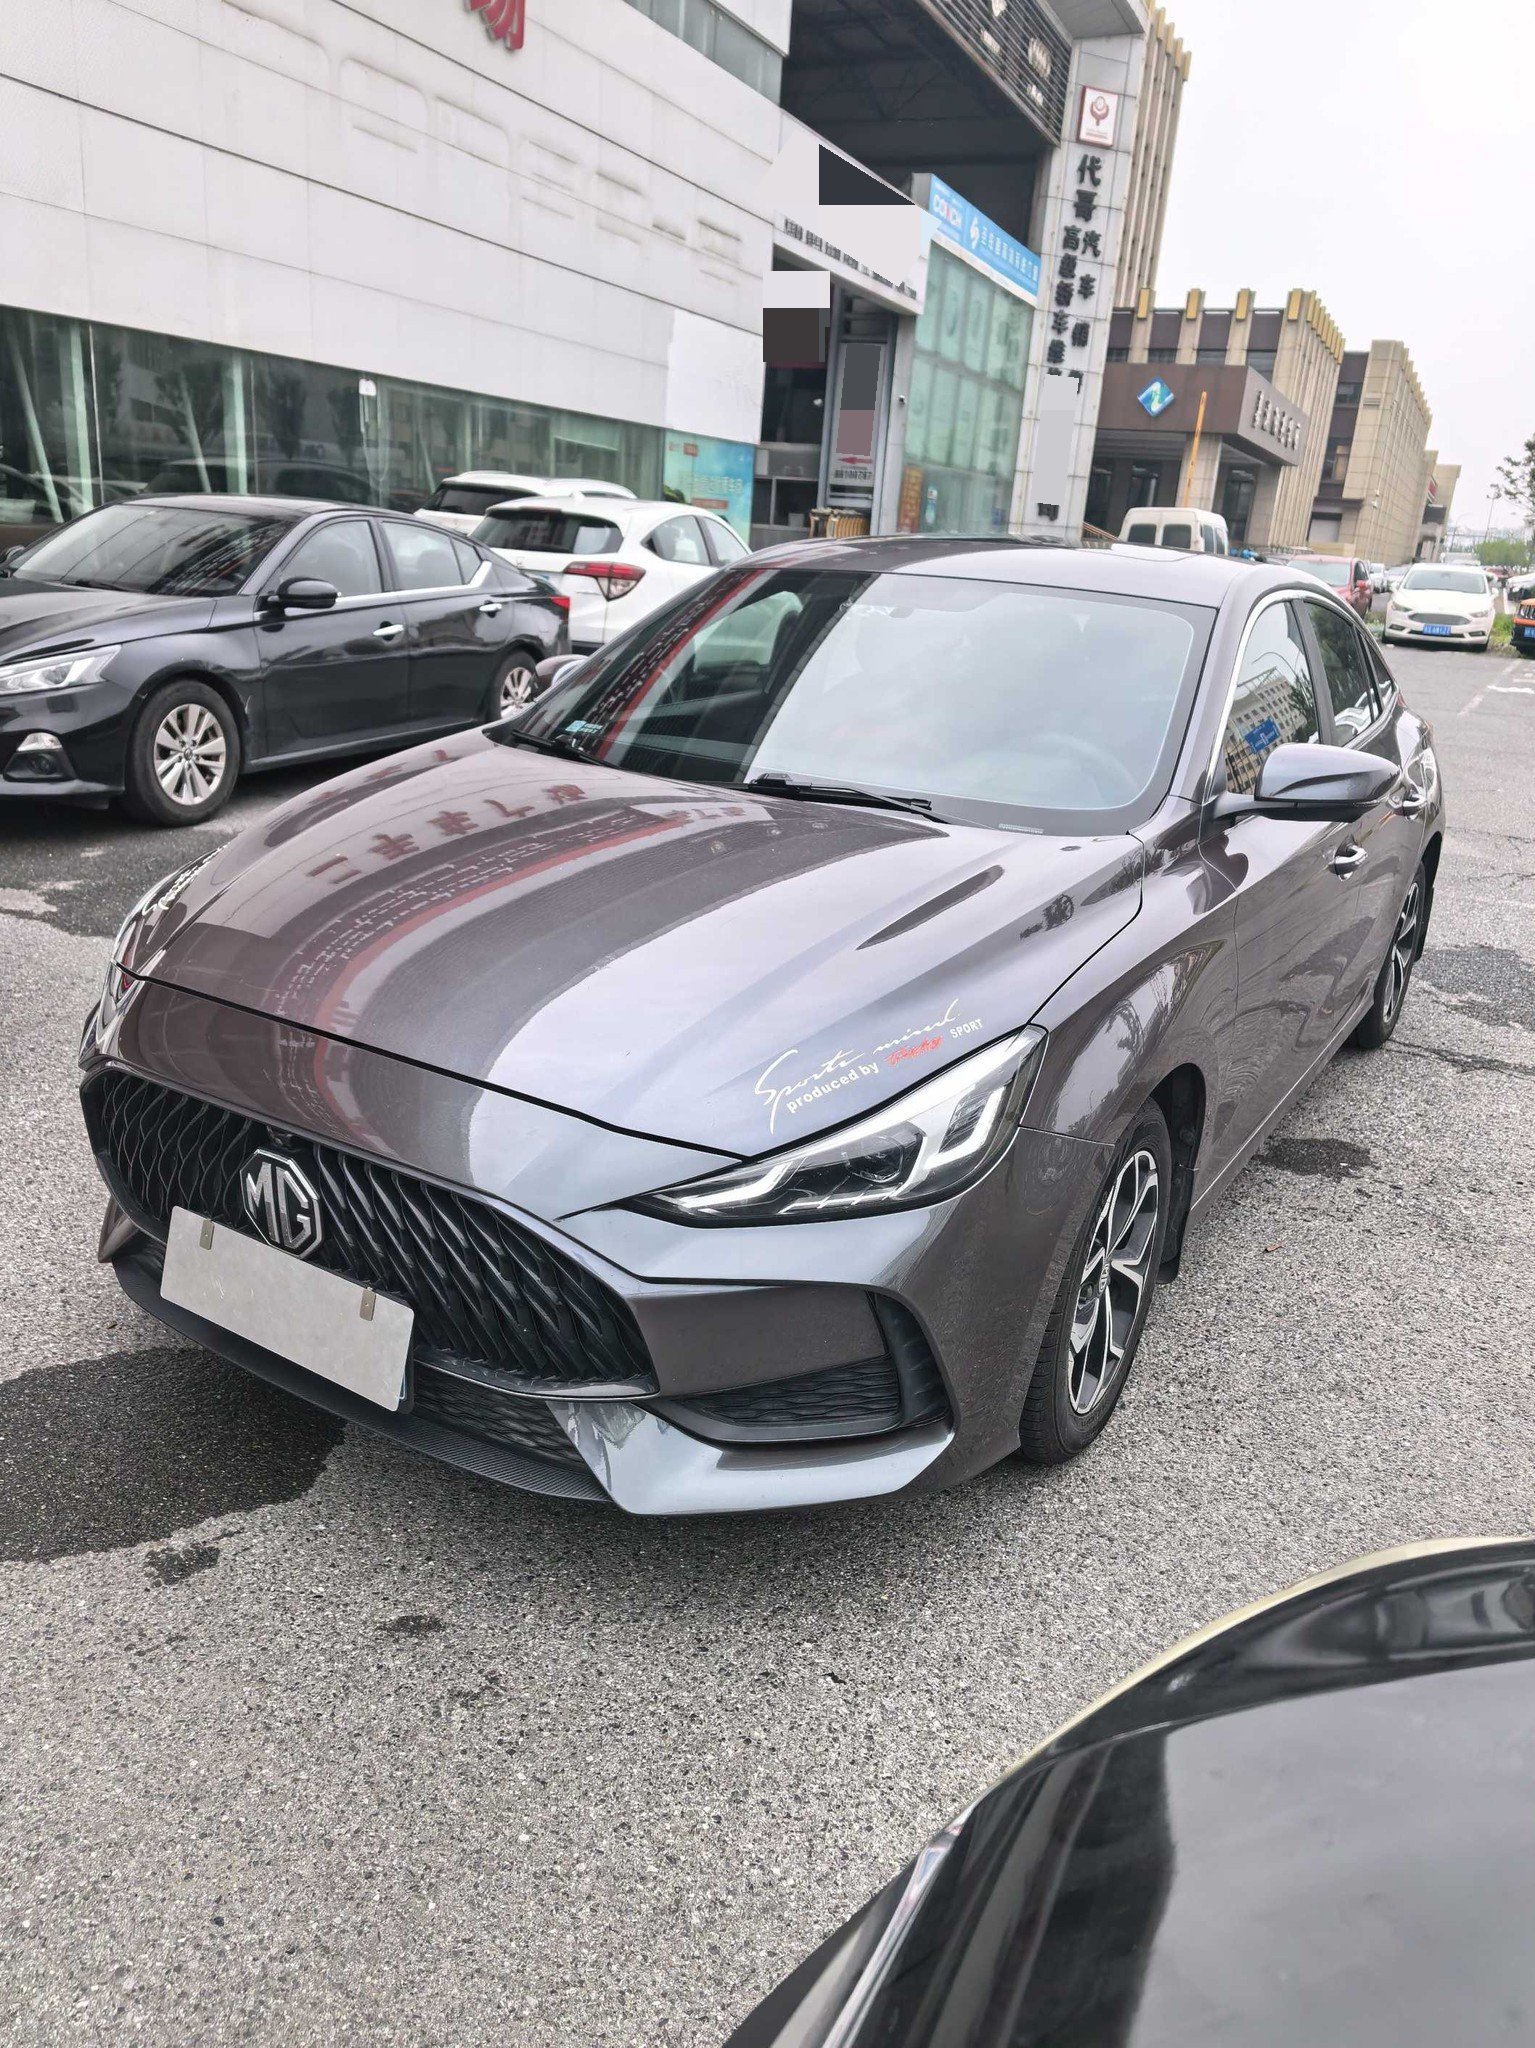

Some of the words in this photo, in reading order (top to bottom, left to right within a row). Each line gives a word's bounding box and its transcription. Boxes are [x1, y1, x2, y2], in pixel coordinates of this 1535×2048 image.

[786, 1069, 859, 1113] produced
[858, 1062, 879, 1075] by
[949, 1018, 984, 1039] SPORT
[246, 1161, 312, 1249] MG
